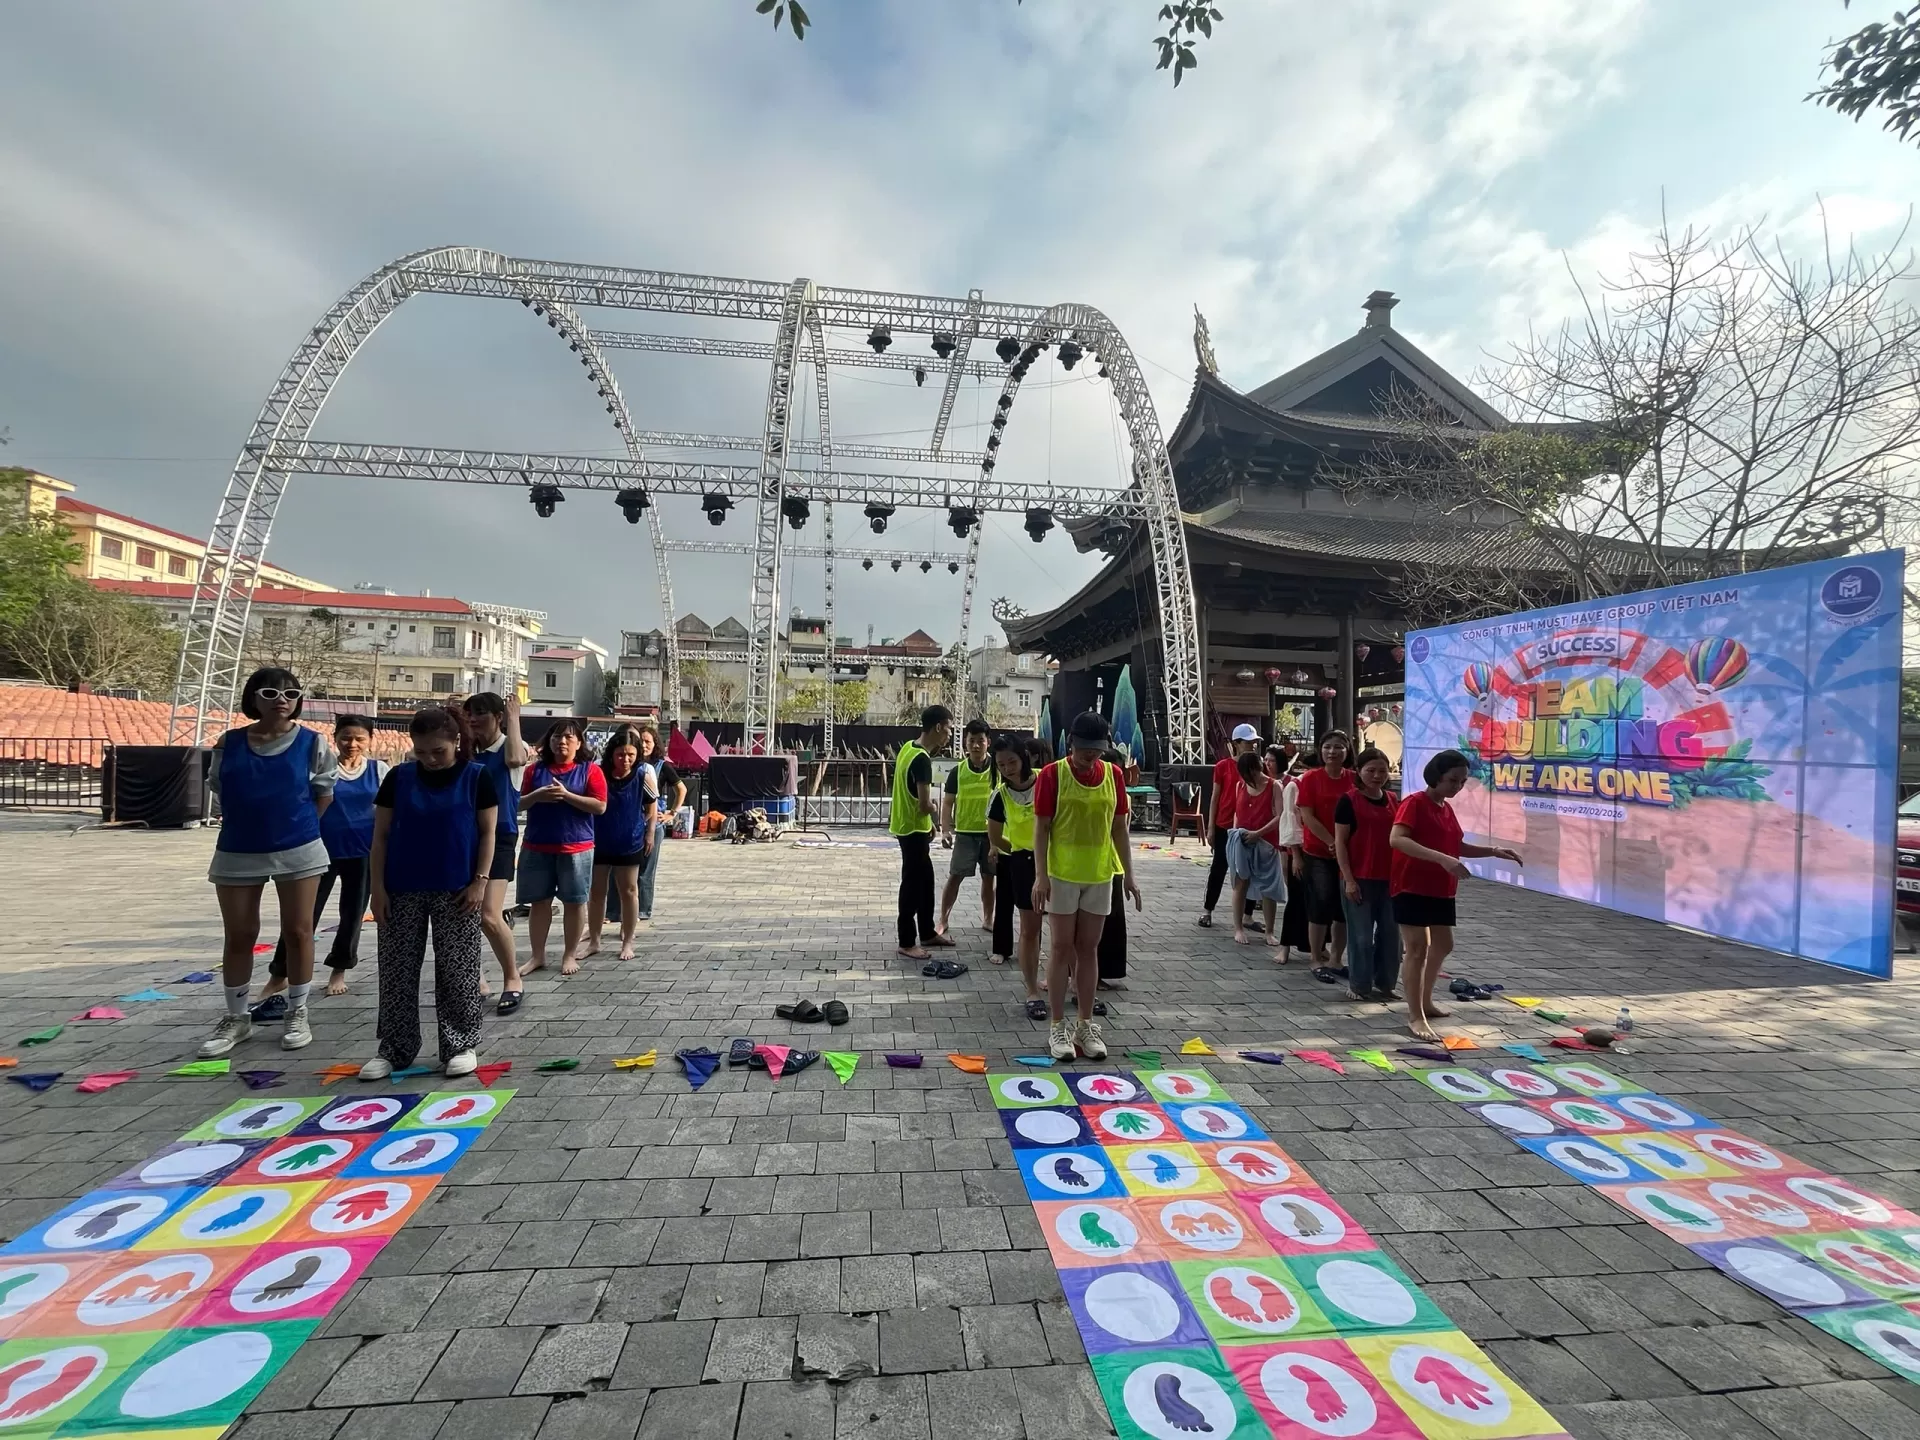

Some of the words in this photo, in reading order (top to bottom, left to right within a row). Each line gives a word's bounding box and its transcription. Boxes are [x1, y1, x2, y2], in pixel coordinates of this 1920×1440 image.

[1491, 626, 1503, 636] TY
[1507, 622, 1534, 634] TNHH
[1537, 616, 1567, 630] MUST
[1571, 610, 1603, 624] HAVE
[1607, 602, 1656, 619] GROUP
[1660, 595, 1695, 612] VIỆT
[1700, 589, 1738, 606] NAM
[1537, 636, 1617, 659] SUCCESS
[1512, 677, 1644, 720] TEAM
[1480, 718, 1706, 768] BUILDING
[1493, 763, 1535, 789] WE
[1537, 765, 1594, 794] ARE
[1598, 768, 1674, 803] ONE
[1578, 806, 1623, 819] 27/02/2026
